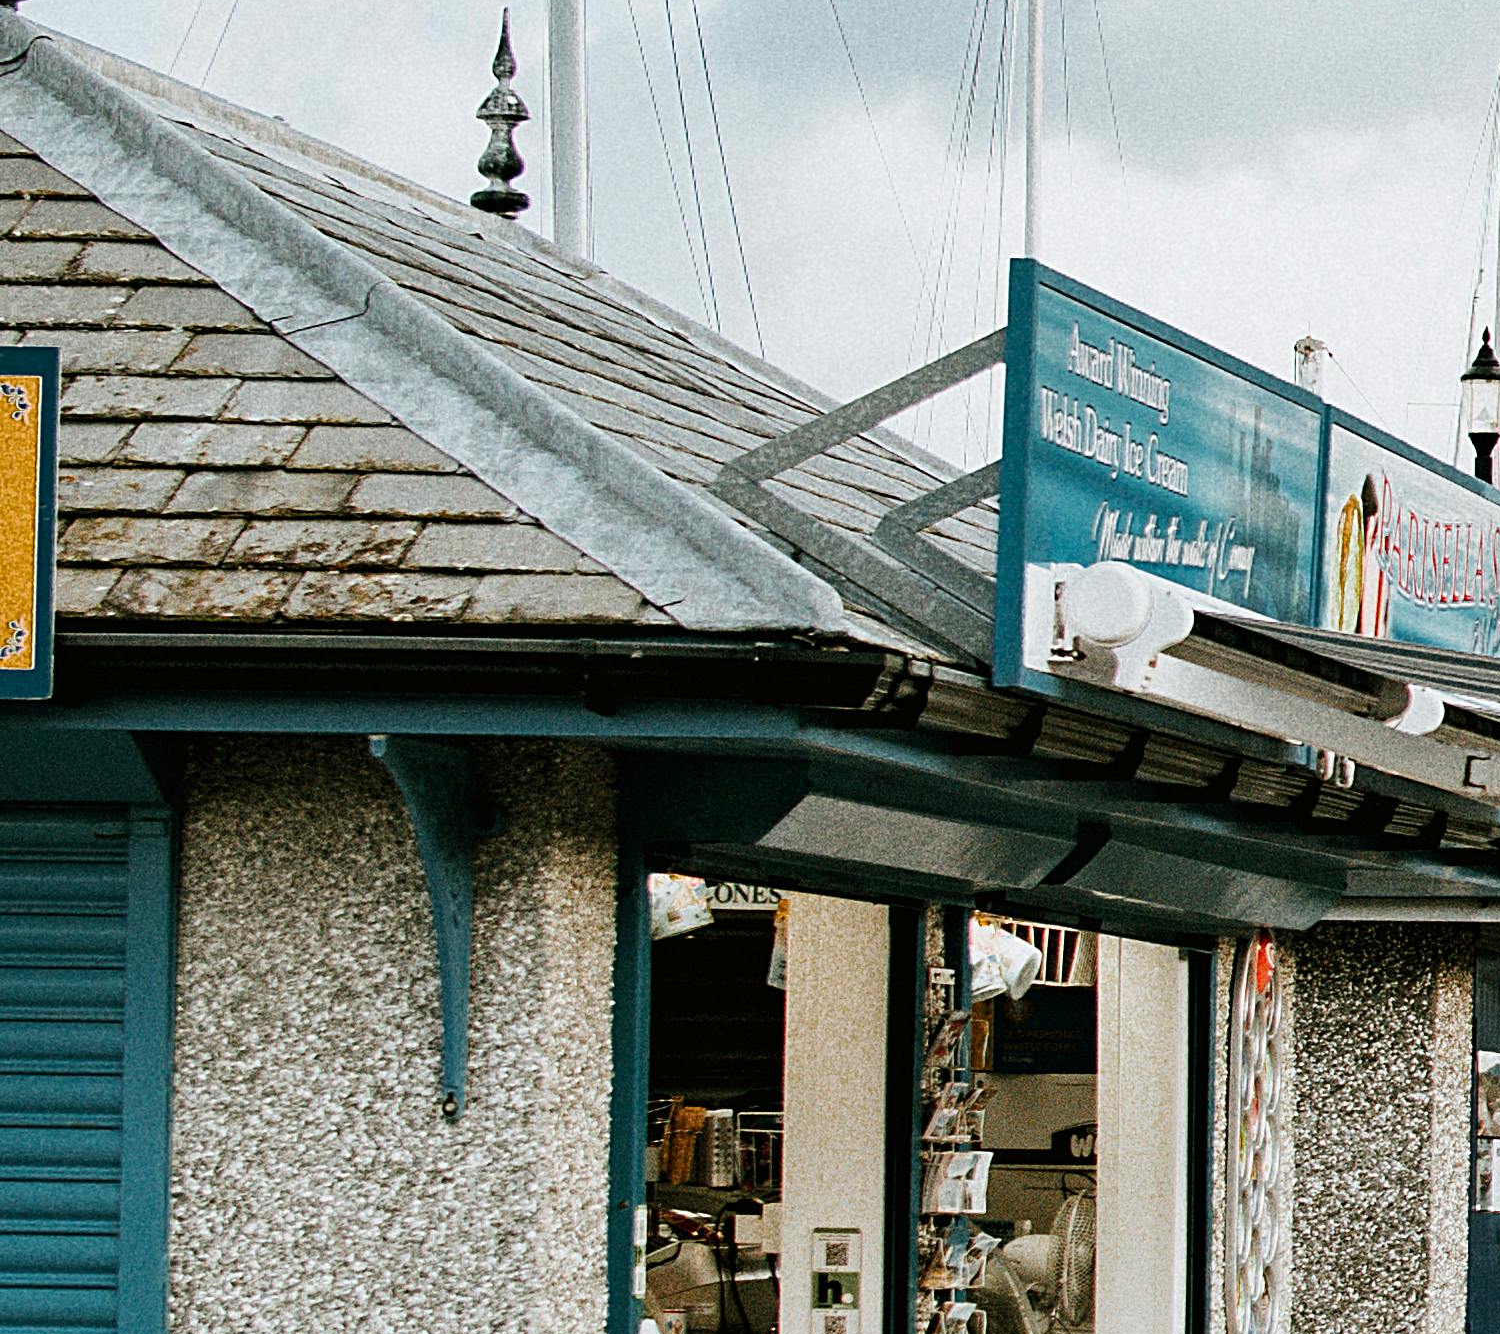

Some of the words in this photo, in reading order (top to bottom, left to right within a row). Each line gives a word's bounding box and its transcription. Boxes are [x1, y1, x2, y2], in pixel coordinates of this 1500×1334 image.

[1067, 320, 1115, 390] Award
[1116, 341, 1171, 426] Winning
[1040, 385, 1083, 454] Welsh
[1083, 404, 1123, 481] Dairy
[1123, 421, 1144, 478] Ice
[1145, 432, 1189, 498] Cream
